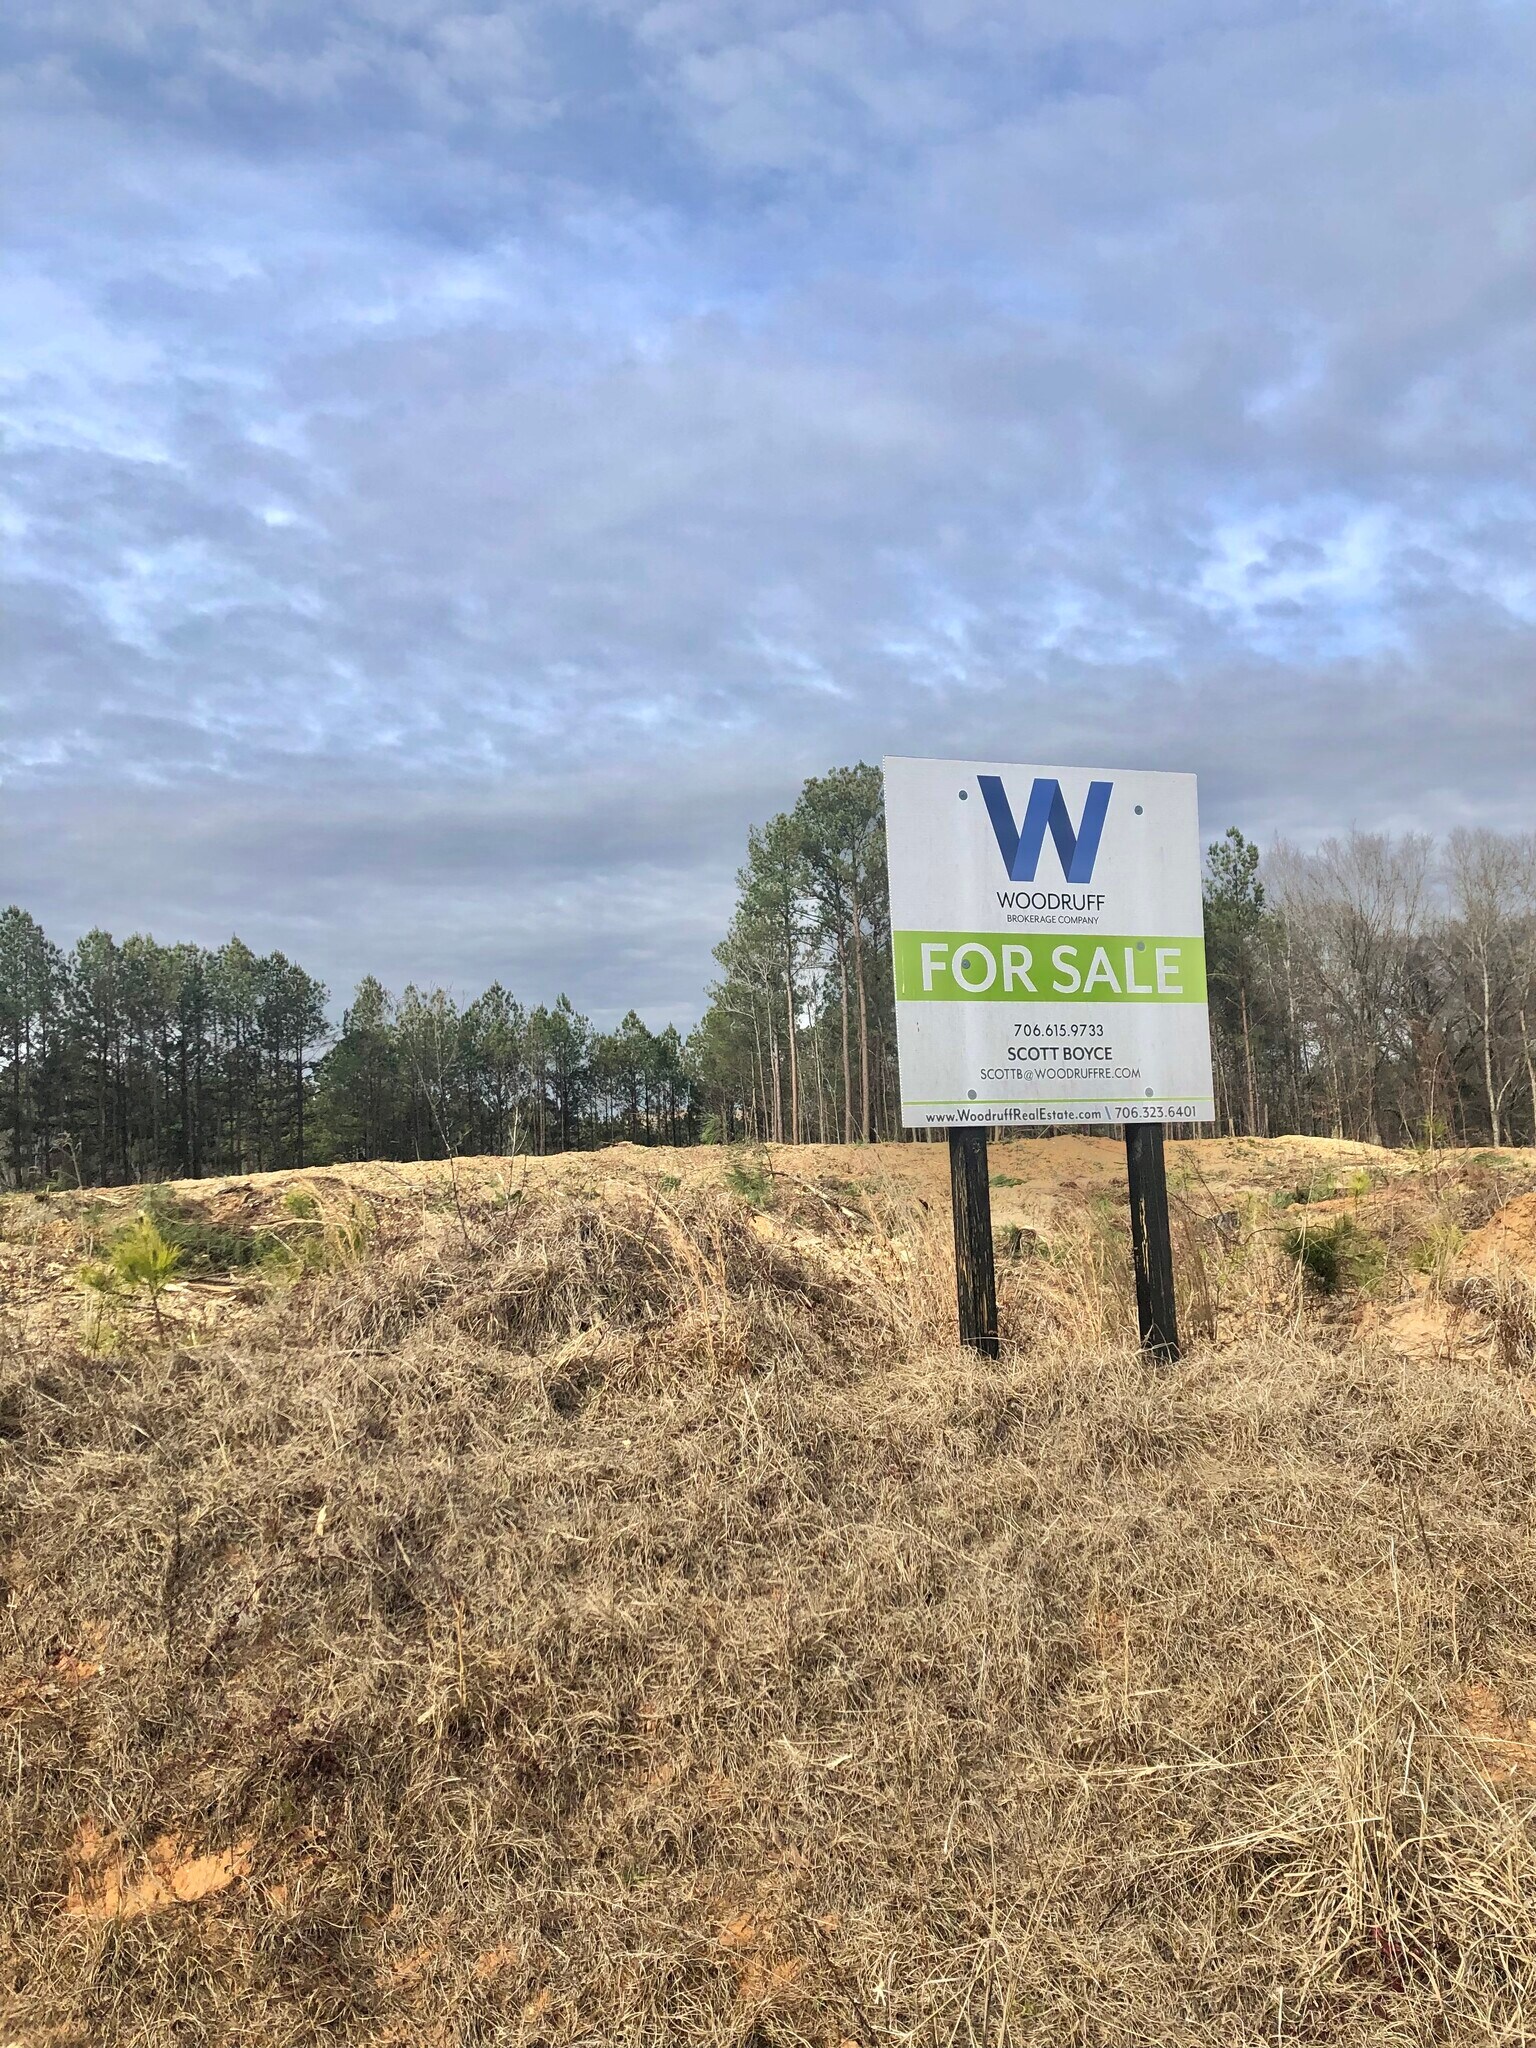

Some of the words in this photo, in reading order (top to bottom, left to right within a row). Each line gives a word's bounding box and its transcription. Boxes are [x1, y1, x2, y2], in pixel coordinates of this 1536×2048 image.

[997, 892, 1106, 911] WOODRUFF
[1007, 914, 1057, 924] BROKERAGE
[1058, 915, 1099, 925] COMPANY
[920, 942, 1038, 993] FOR
[1051, 945, 1183, 994] SALE
[1014, 1023, 1104, 1037] 706.615.9733
[1007, 1047, 1059, 1061] SCOTT
[1063, 1047, 1113, 1061] BOYCE
[980, 1067, 1141, 1081] SCOTTB@WOODRUFFRE.COM
[925, 1108, 1102, 1124] www.WoodruffRealEstate.com
[1115, 1106, 1197, 1120] 706.323.6401
